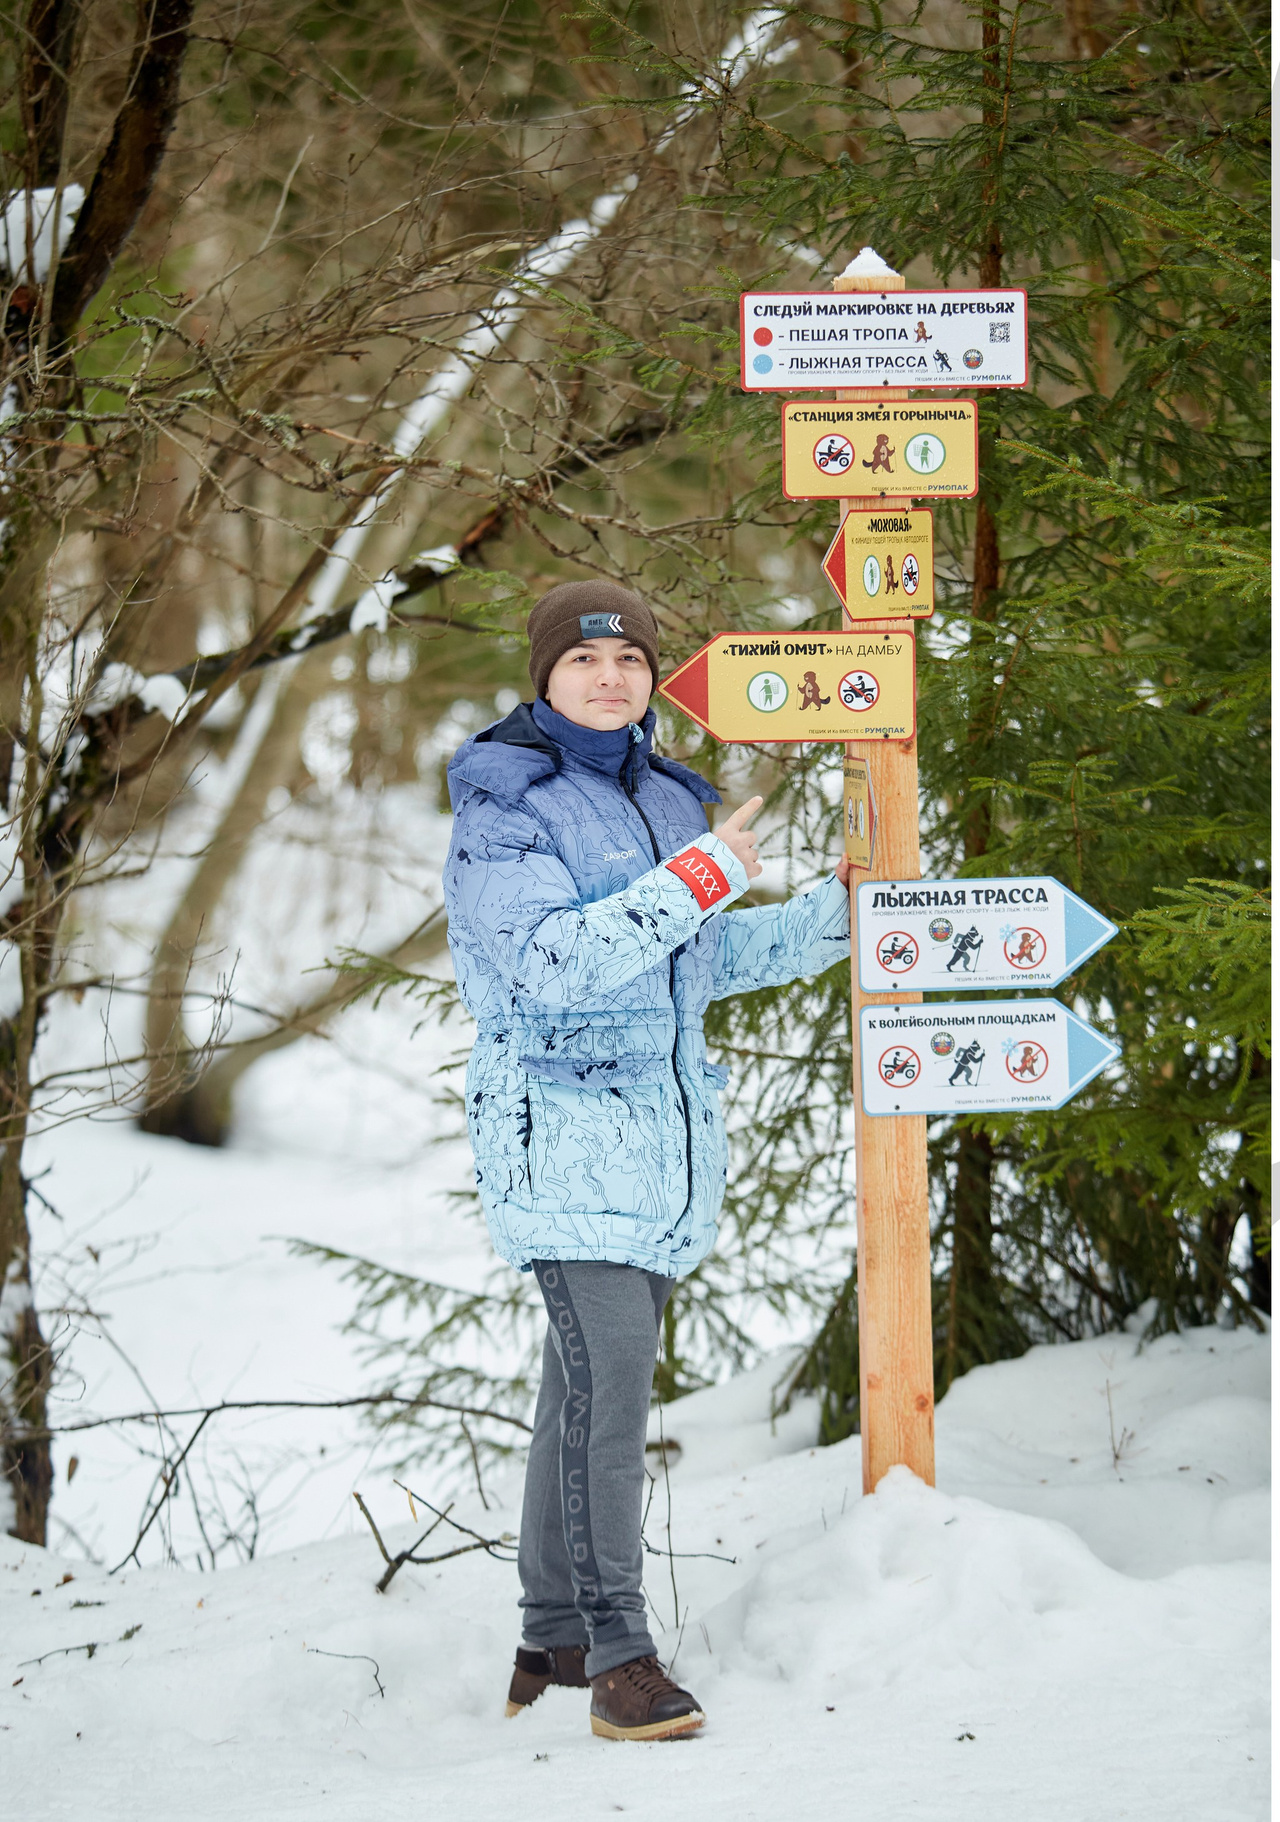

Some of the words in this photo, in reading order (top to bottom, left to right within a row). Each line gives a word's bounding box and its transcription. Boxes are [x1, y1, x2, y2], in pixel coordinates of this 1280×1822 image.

[753, 301, 812, 318] СЛЕДУЙ
[816, 302, 913, 316] МАРКИРОВКЕ
[917, 302, 937, 315] НА
[940, 301, 1015, 316] ДЕРЕВЬЯХ
[789, 328, 849, 342] ПЕШАЯ
[852, 328, 909, 341] ТРОПА
[788, 356, 861, 369] ЛЫЖНАЯ
[865, 355, 928, 368] ТРАССА
[788, 411, 854, 424] «СТАНЦИЯ
[856, 411, 890, 421] ЗМЕЯ
[893, 410, 972, 421] ГОРЫНЫЧА»
[722, 640, 780, 656] «ТИХИЙ
[784, 643, 832, 656] ОМУТ»
[836, 645, 854, 656] НА
[856, 644, 903, 657] ДАМБУ
[603, 849, 638, 862] ZASPORT
[871, 890, 967, 908] ЛЫЖНАЯ
[971, 888, 1048, 905] ТРАССА
[868, 1020, 876, 1029] К
[879, 1016, 975, 1028] ВОЛЕЙБОЛЬНЫМ
[978, 1013, 1056, 1026] ПЛОЩАДКАМ
